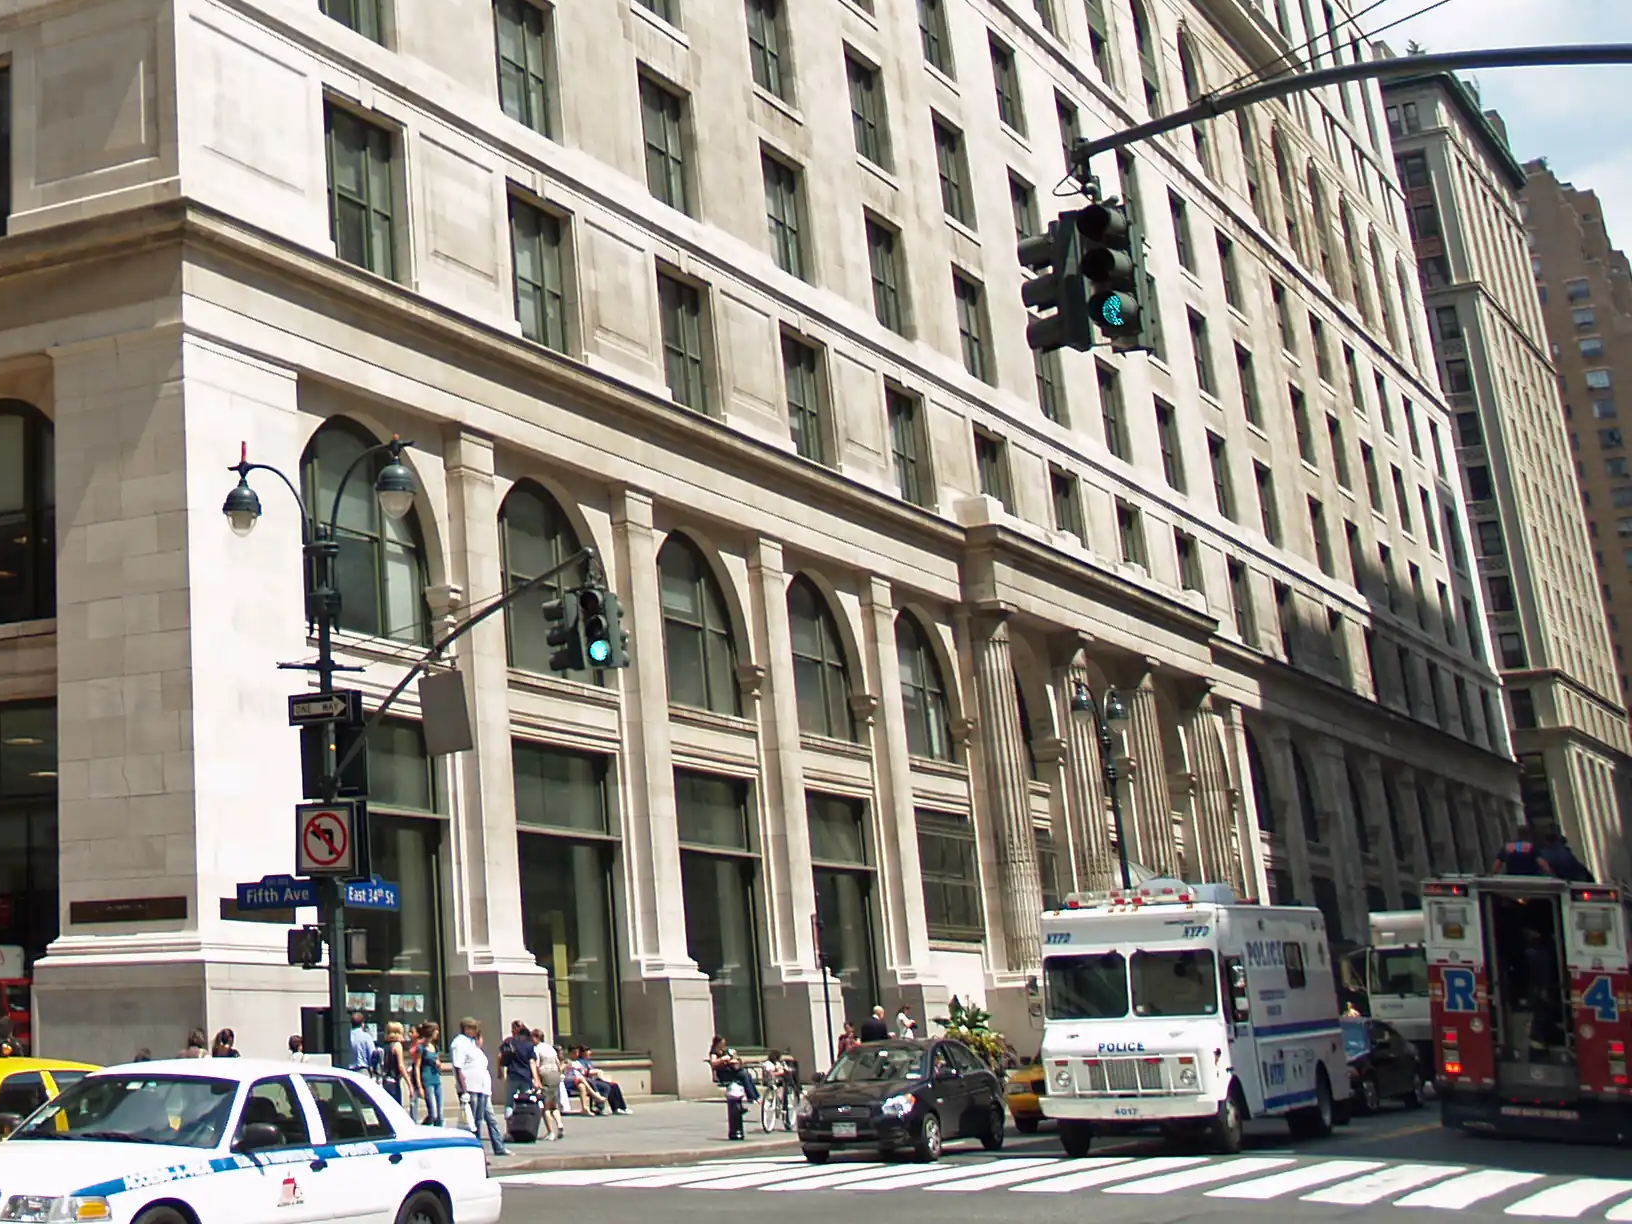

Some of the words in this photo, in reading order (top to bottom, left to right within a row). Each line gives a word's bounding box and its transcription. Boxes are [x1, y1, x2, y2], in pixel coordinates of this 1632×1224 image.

[246, 888, 279, 904] Fifth
[283, 887, 310, 902] Ave
[348, 886, 366, 902] East
[368, 887, 384, 904] 34th
[385, 890, 396, 905] St
[1044, 932, 1072, 945] NYPD
[1182, 925, 1210, 939] NYPD
[1245, 939, 1285, 968] POLICE
[1441, 967, 1477, 1012] R
[1582, 975, 1619, 1023] 4
[1098, 1042, 1145, 1053] POLICE
